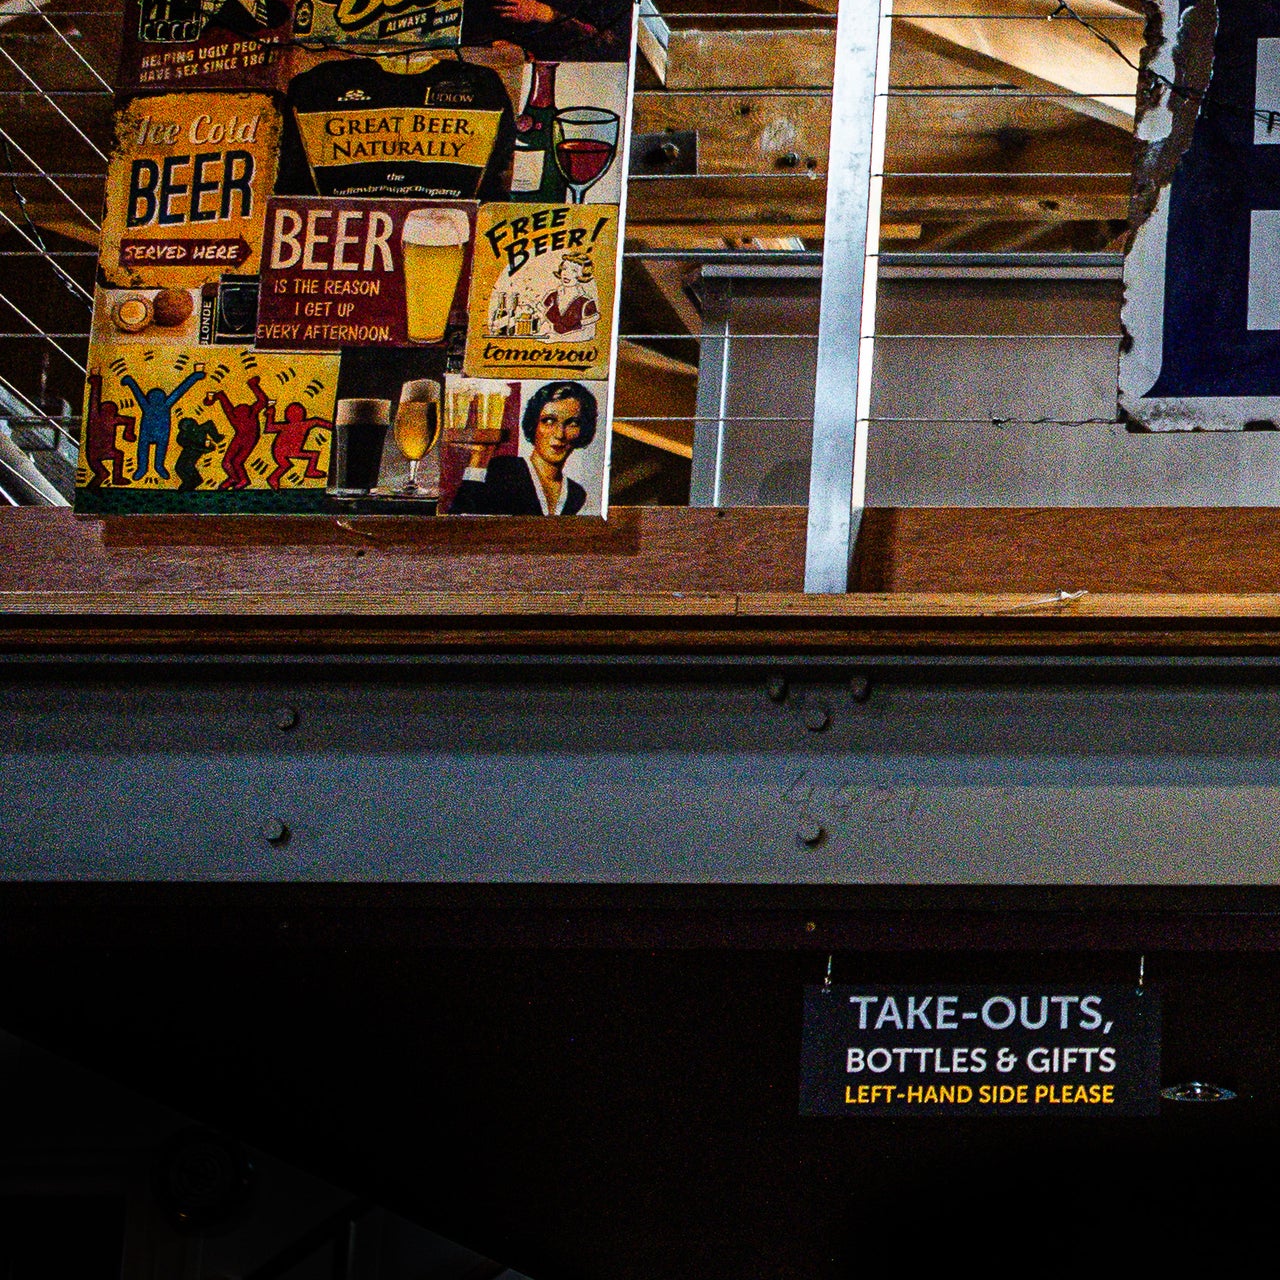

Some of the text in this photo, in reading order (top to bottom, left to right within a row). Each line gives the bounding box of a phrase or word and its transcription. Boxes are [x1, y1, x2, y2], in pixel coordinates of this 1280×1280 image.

[385, 12, 428, 33] ALWAYS
[141, 49, 195, 68] HELPING
[198, 43, 230, 60] UGLY
[139, 67, 171, 83] HAVE
[175, 63, 199, 78] SEX
[202, 57, 239, 74] SINCE
[423, 86, 475, 106] LUDLOW
[135, 114, 259, 146] Ice Cold
[325, 115, 475, 137] GREAT BEER,
[332, 140, 465, 160] NATURALLY
[126, 150, 255, 229] BEER
[269, 208, 395, 273] BEER
[485, 208, 570, 259] FREE
[124, 243, 240, 261] SERVED HERE
[504, 217, 609, 277] BEER!
[273, 278, 382, 297] IS THE REASON
[294, 301, 356, 318] I GET UP
[257, 323, 394, 342] EVERY AFTERNOON.
[482, 342, 599, 363] tomorrow
[849, 995, 1114, 1034] TAKE-OUTS,
[846, 1047, 1117, 1074] BOTTLES & GIFTS
[845, 1085, 1115, 1104] LEFT-HAND SIDE PLEASE
